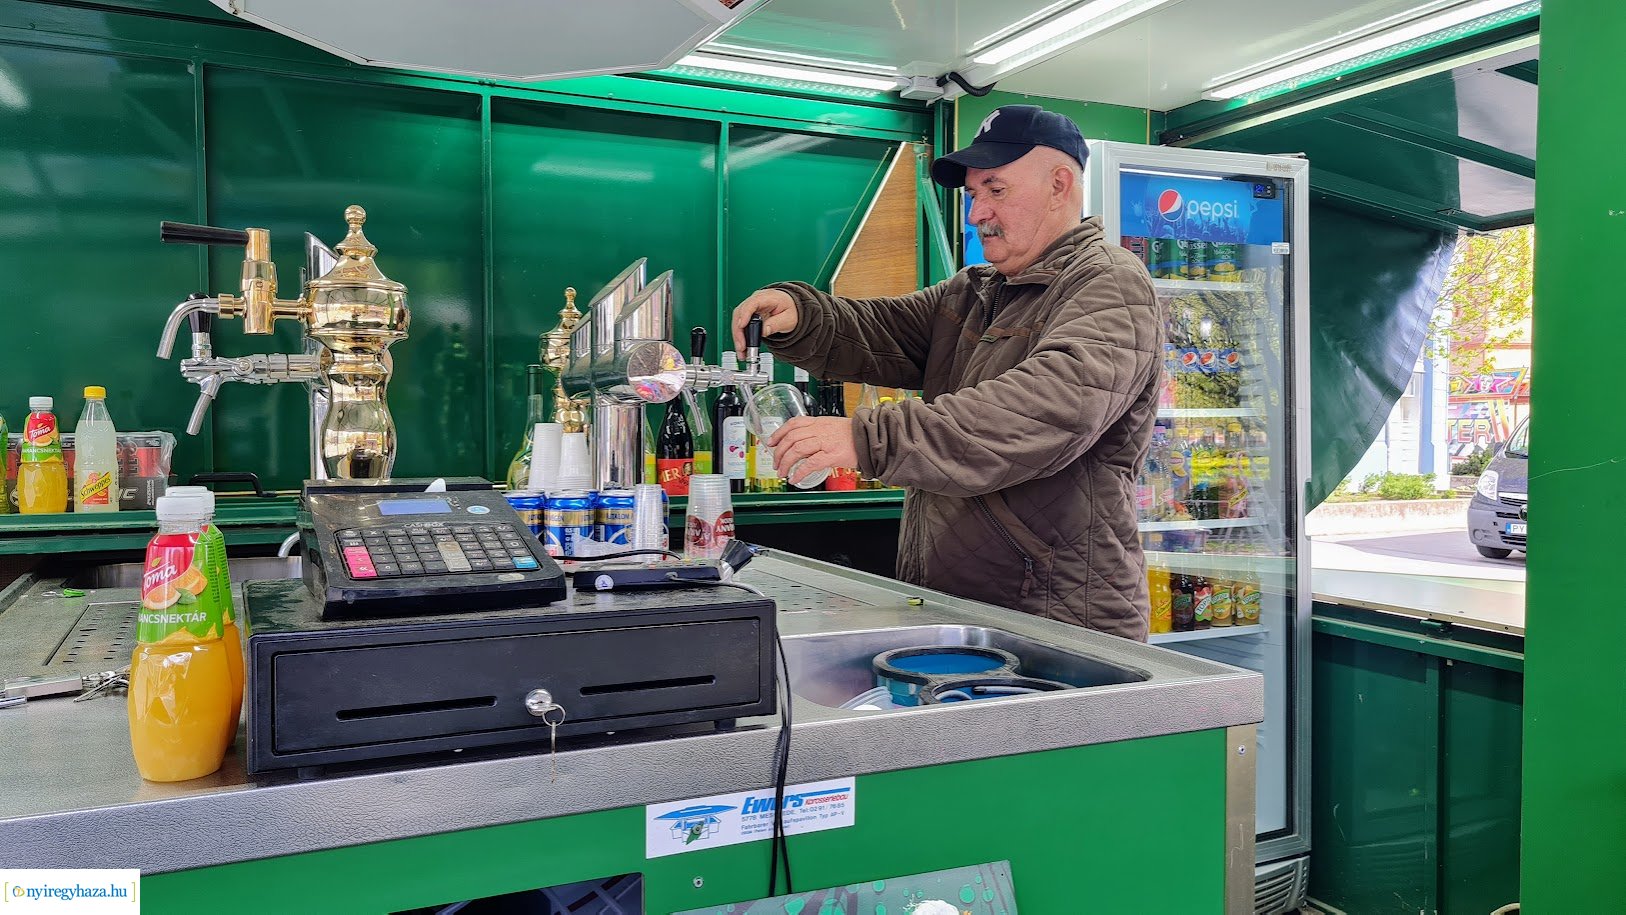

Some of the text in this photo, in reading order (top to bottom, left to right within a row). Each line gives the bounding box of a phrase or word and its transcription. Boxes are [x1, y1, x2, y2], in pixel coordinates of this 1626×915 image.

[1187, 200, 1238, 221] pepsi
[80, 476, 112, 498] Schweppes
[741, 794, 803, 815] Ewrs
